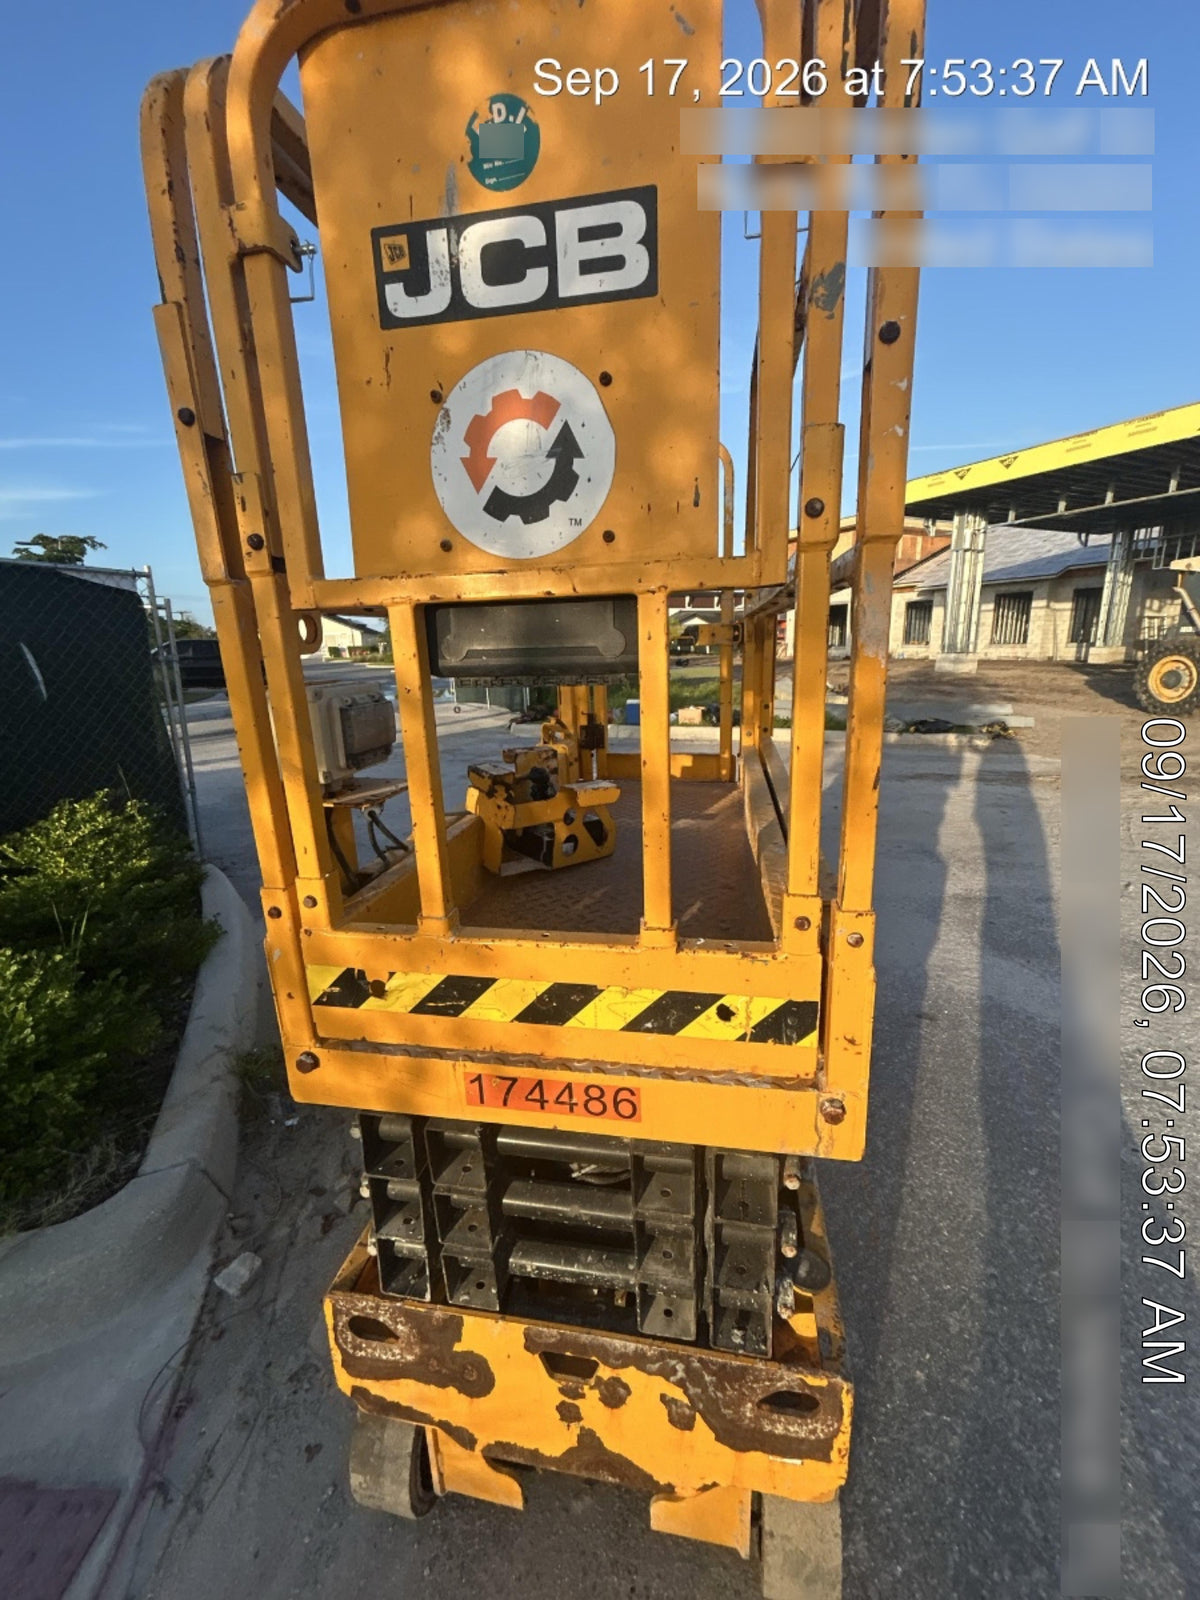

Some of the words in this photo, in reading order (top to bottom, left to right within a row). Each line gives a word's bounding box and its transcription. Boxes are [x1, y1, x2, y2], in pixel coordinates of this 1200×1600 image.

[384, 200, 650, 318] JCB
[568, 517, 583, 527] TM
[469, 1073, 638, 1120] 174486
